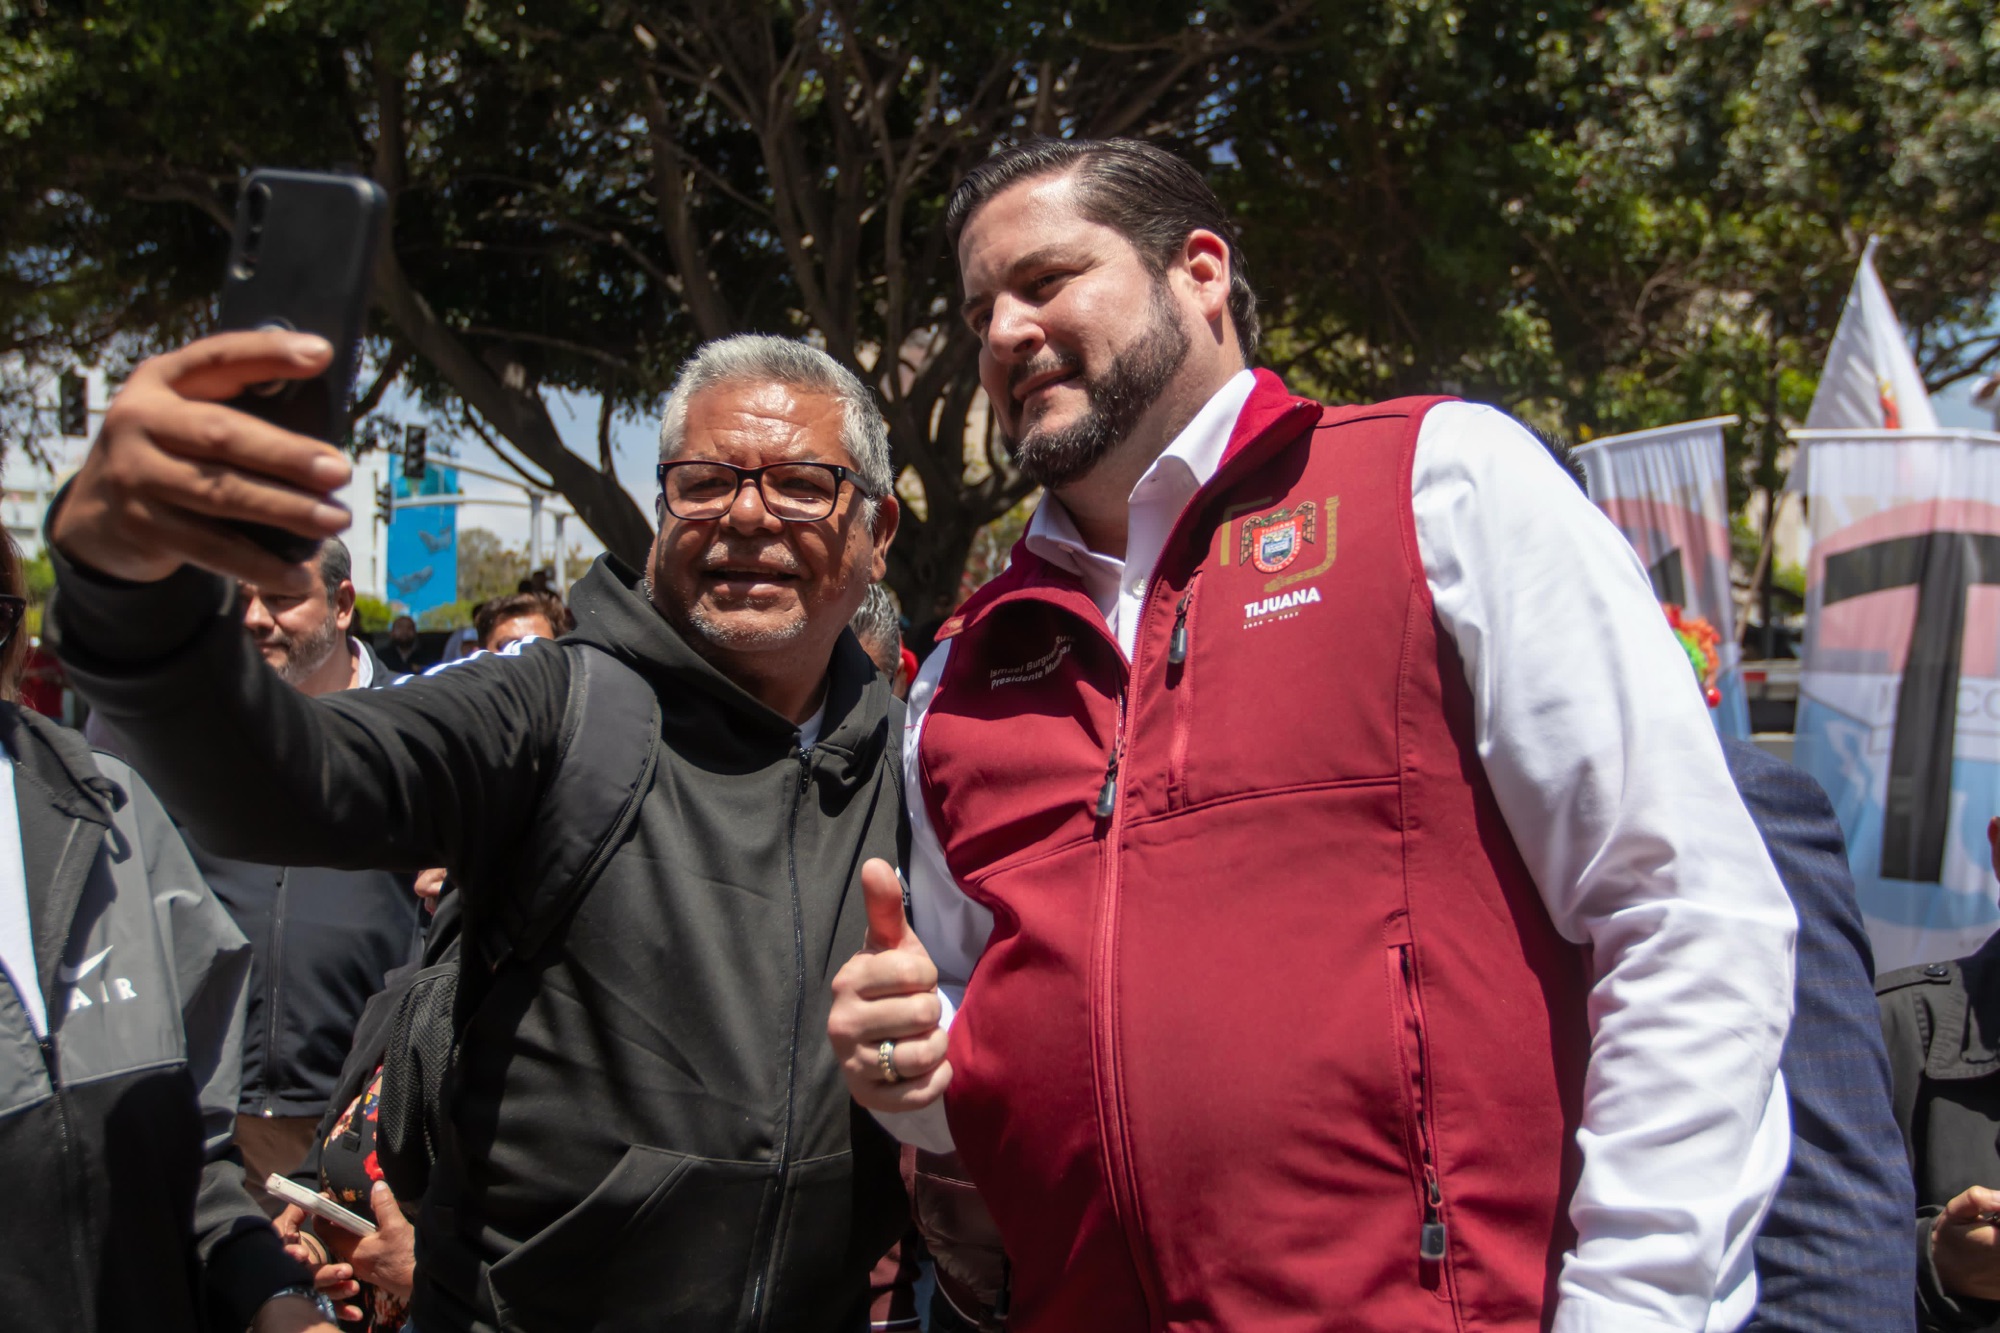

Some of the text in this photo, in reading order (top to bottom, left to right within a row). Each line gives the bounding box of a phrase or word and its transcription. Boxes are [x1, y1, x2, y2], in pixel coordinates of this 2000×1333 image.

[1244, 586, 1321, 618] TIJUANA
[990, 664, 1024, 679] Ismael
[991, 671, 1043, 690] Presidente
[69, 977, 138, 1011] AIR
